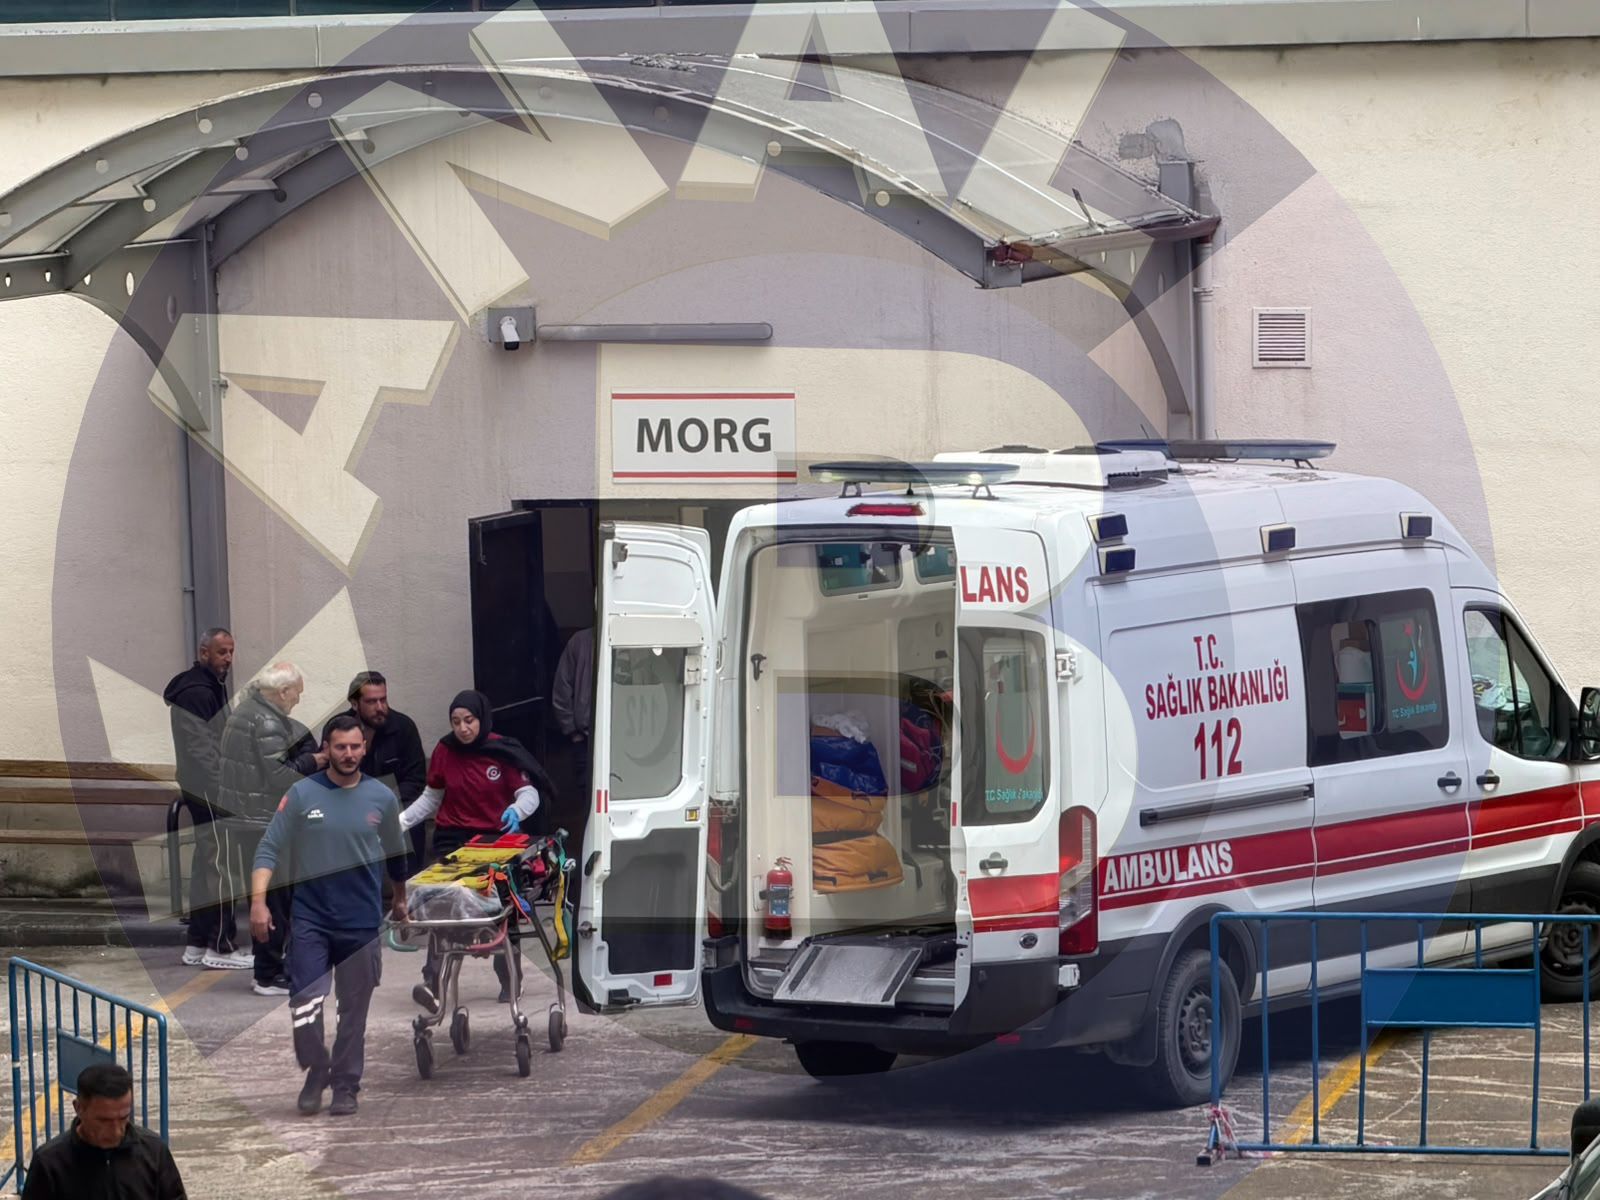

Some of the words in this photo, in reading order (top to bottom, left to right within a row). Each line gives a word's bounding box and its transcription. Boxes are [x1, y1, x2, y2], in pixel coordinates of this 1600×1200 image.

[637, 417, 771, 453] MORG
[960, 566, 1029, 603] LANS
[1193, 634, 1224, 671] T.C.
[1145, 673, 1204, 720] SAĞLIK
[1207, 658, 1289, 711] BAKANLIĞI
[1194, 717, 1242, 780] 112
[1103, 841, 1233, 893] AMBULANS
